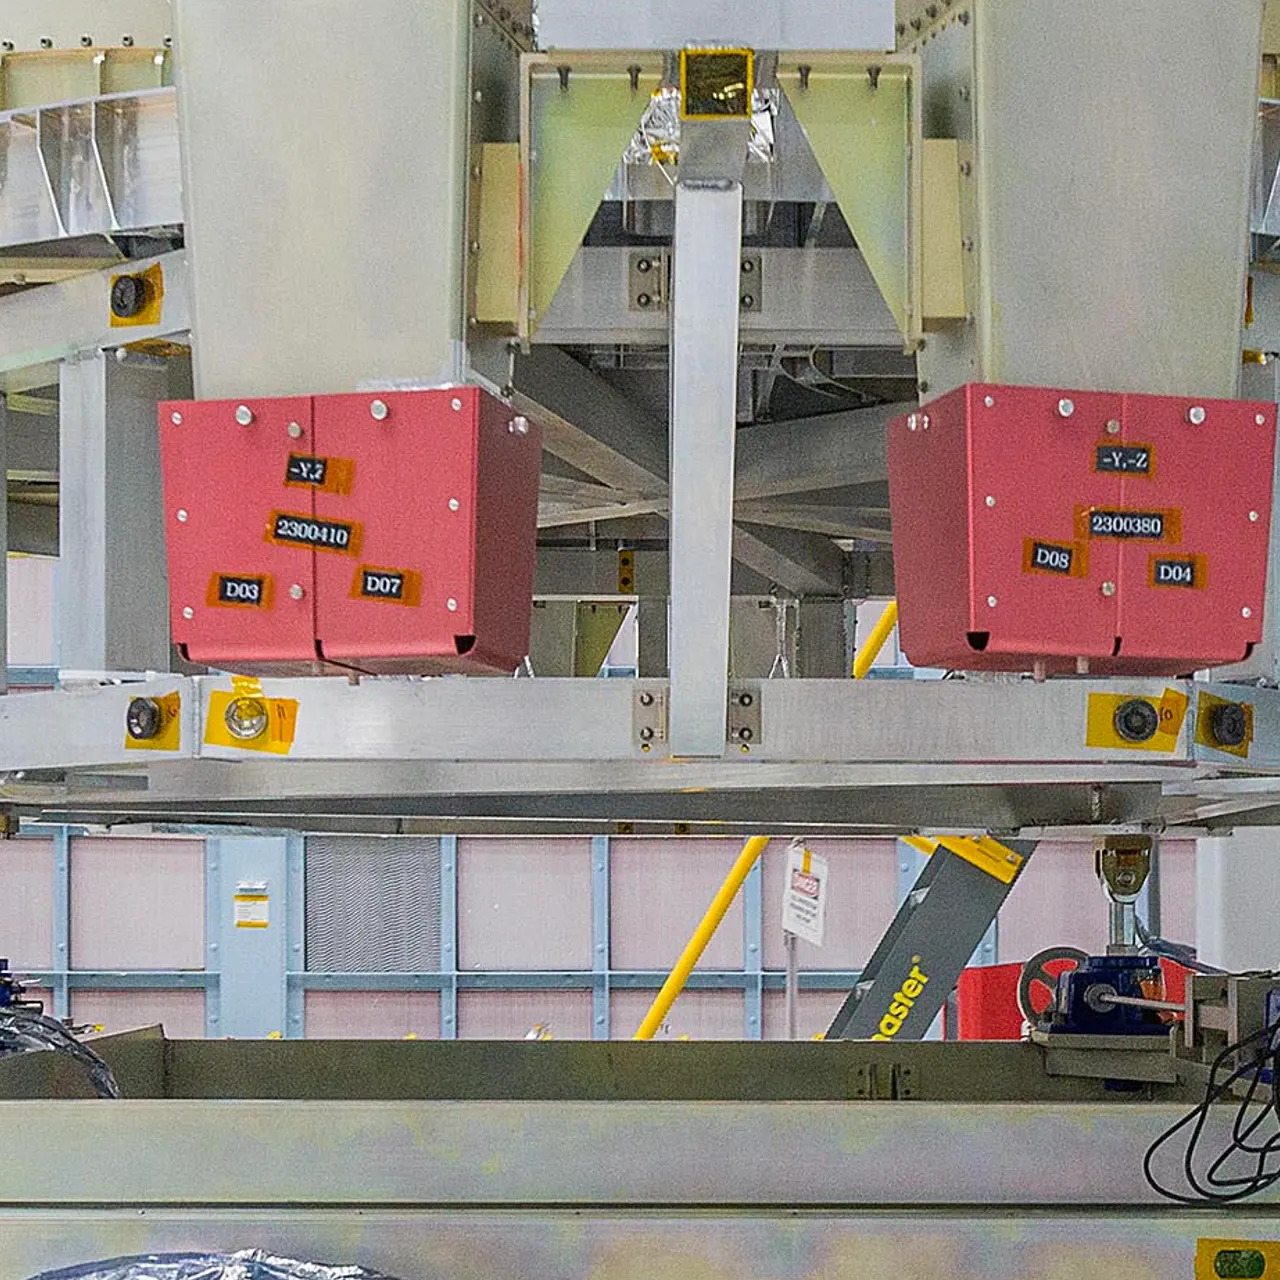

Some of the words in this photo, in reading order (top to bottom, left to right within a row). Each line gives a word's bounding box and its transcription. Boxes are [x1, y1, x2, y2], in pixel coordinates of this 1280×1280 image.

[276, 519, 349, 546] 2300410
[1092, 515, 1162, 534] 2300380
[1036, 548, 1070, 569] D08
[1159, 565, 1192, 582] D04
[225, 581, 259, 600] D03
[366, 575, 402, 594] D07
[871, 965, 929, 1040] aster
